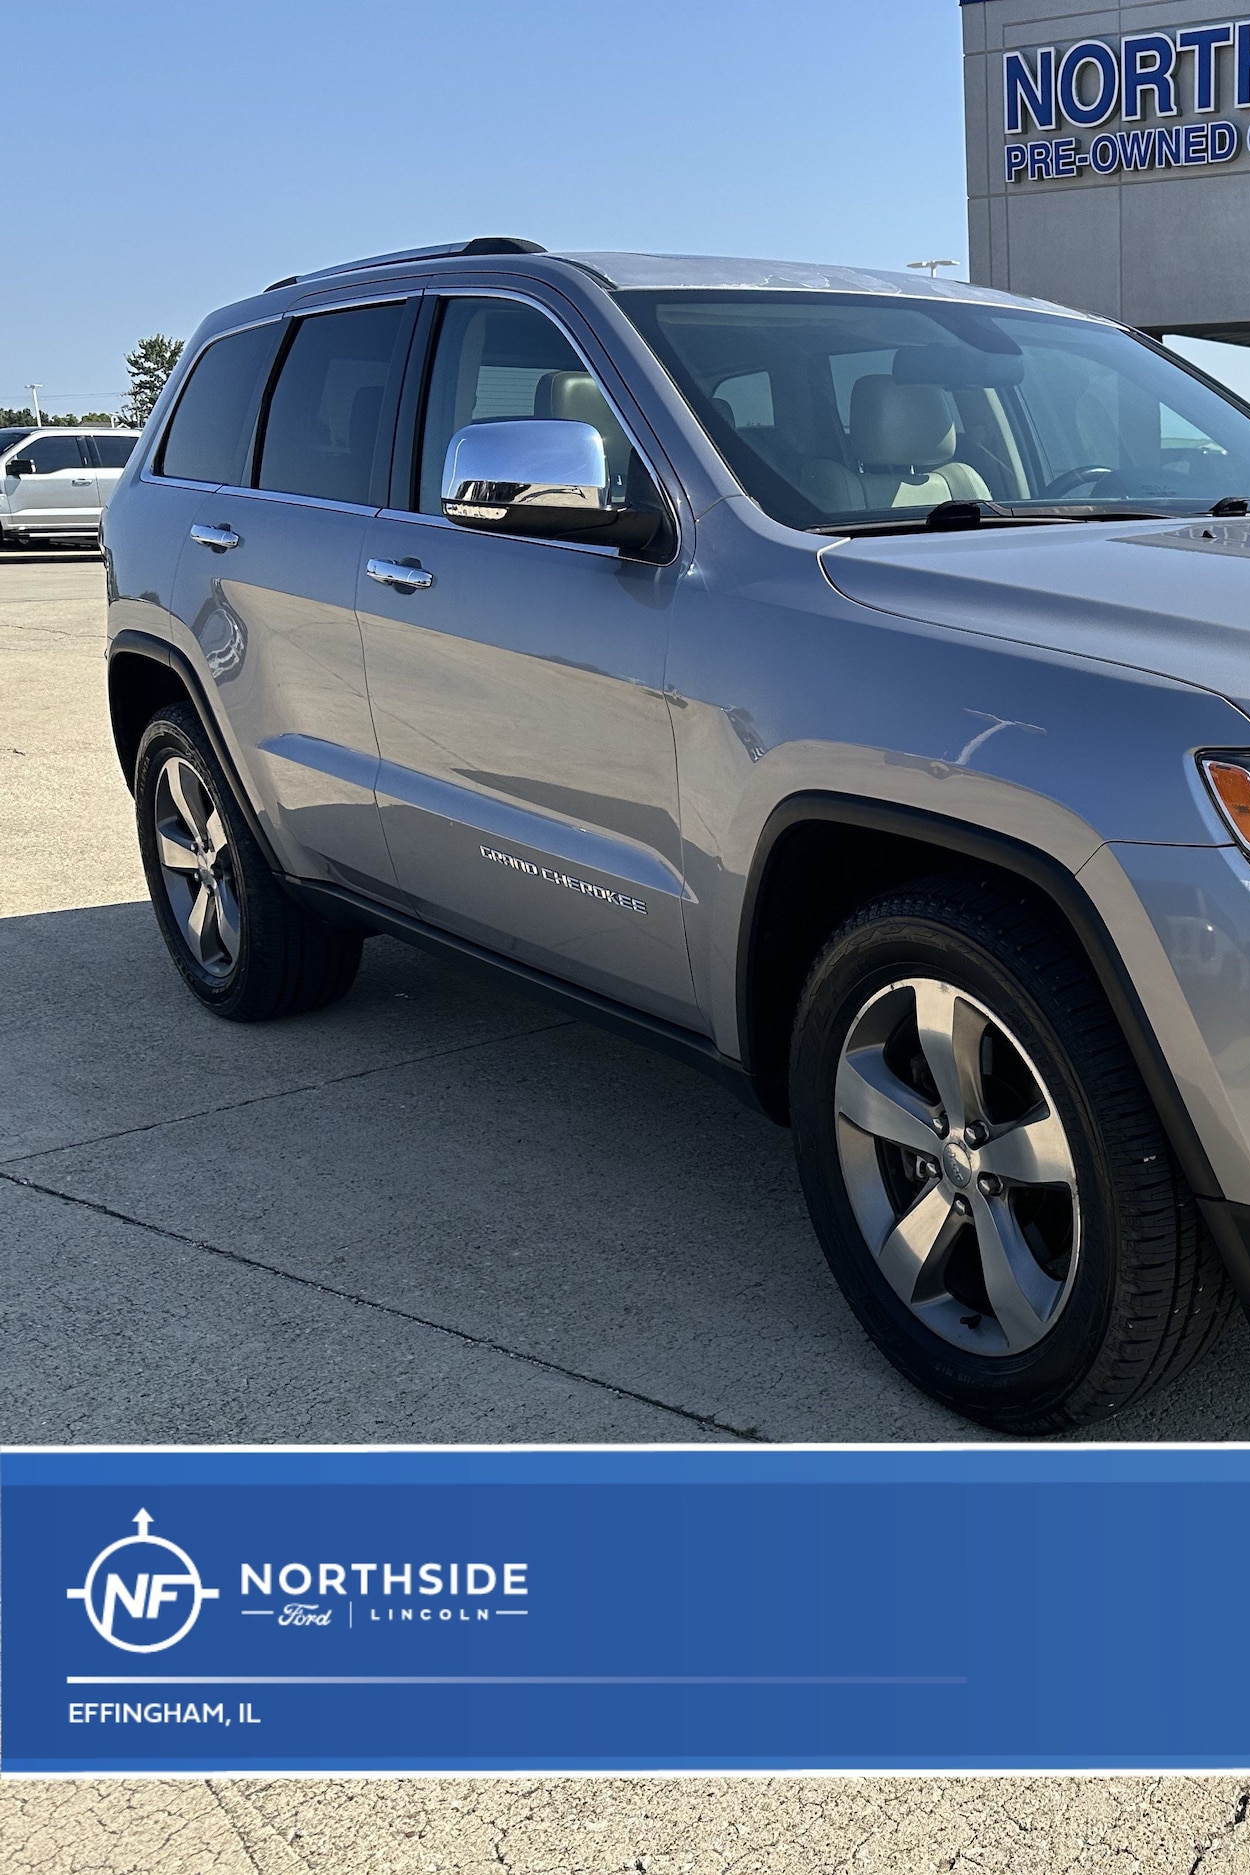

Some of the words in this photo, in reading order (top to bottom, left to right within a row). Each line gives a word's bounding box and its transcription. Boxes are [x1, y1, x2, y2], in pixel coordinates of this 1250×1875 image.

[1005, 119, 1239, 184] PRE-OWNED
[479, 845, 539, 876] GRAND
[541, 867, 648, 915] CHEROKEE
